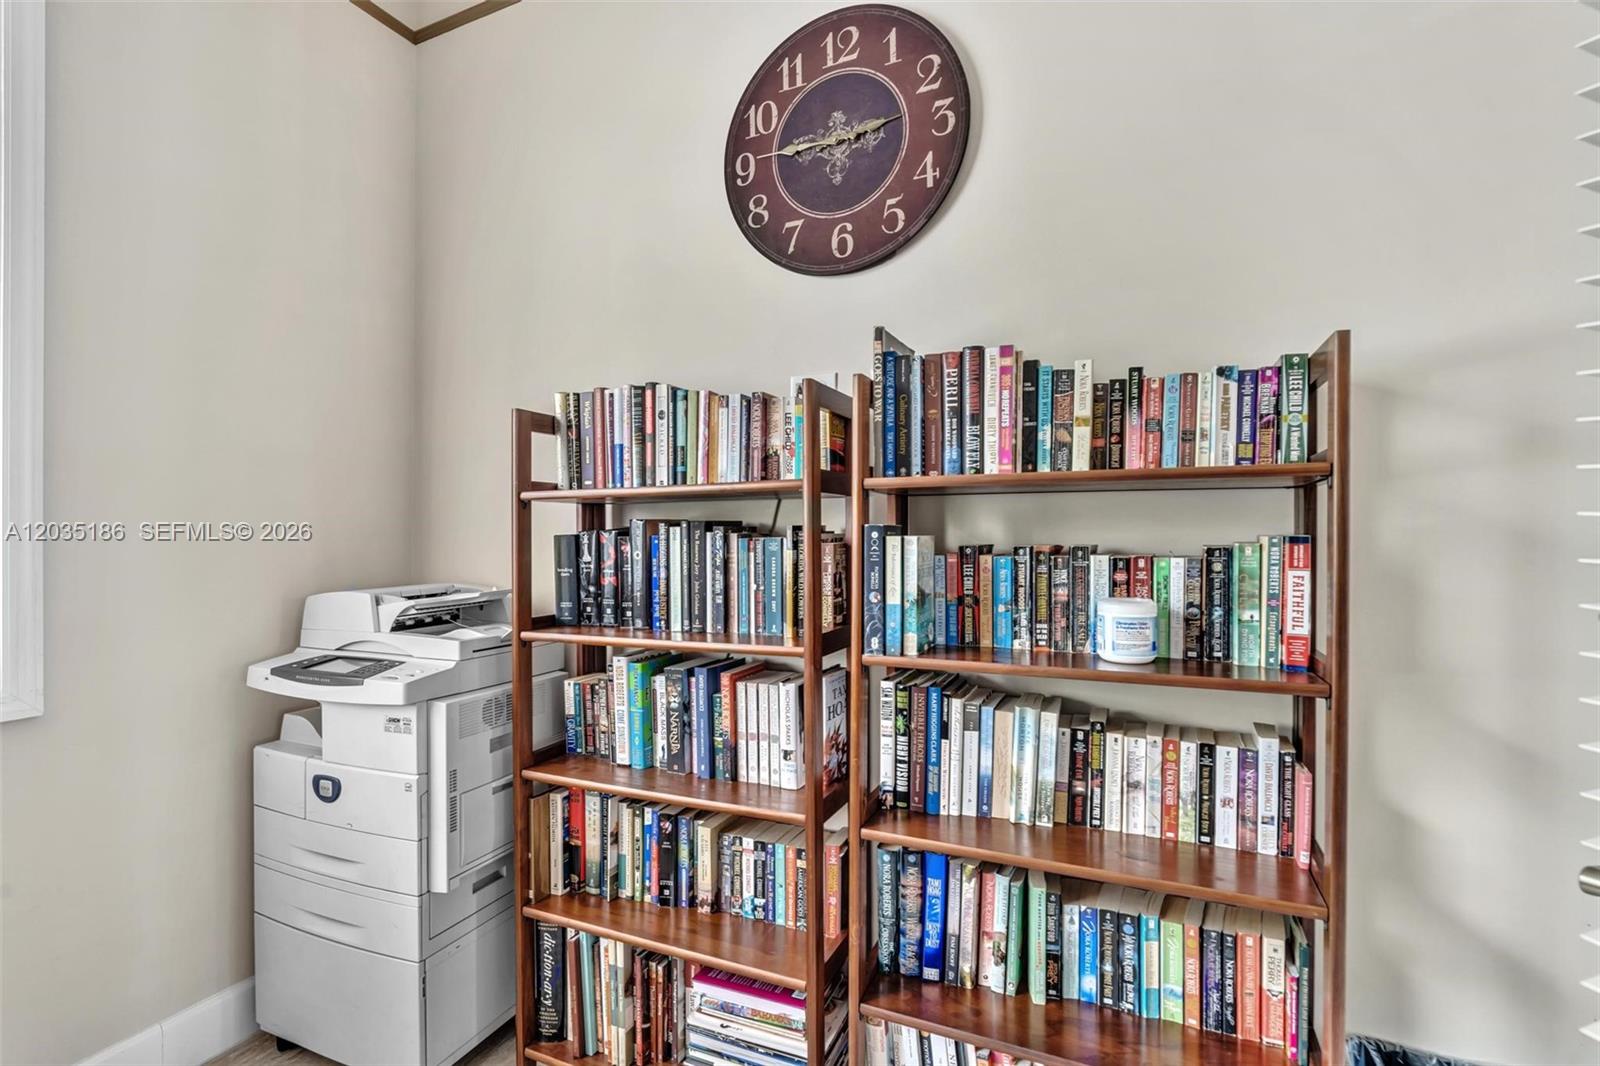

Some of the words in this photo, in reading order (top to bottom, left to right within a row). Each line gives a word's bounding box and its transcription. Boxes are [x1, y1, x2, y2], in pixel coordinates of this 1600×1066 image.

[820, 26, 860, 69] 12
[882, 27, 902, 65] 1
[777, 53, 807, 94] 11
[915, 54, 942, 94] 2
[744, 100, 778, 140] 10
[931, 97, 956, 136] 3
[735, 152, 756, 187] 9
[913, 151, 940, 188] 4
[747, 194, 769, 228] 8
[881, 194, 906, 234] 5
[782, 218, 805, 255] 7
[831, 222, 854, 258] 6
[874, 355, 883, 383] GOES
[873, 385, 882, 399] TO
[946, 368, 958, 411] PERIL
[1041, 378, 1049, 399] STARTS
[1290, 376, 1303, 389] LEE
[873, 400, 882, 422] WAR
[898, 394, 908, 425] Culinary
[1041, 401, 1049, 419] WITH
[1242, 396, 1250, 416] MICHAEL
[1260, 384, 1271, 414] BRENNAN
[1290, 390, 1303, 412] CHILD
[583, 401, 591, 429] Whiplash
[752, 403, 760, 420] NORA
[784, 412, 792, 427] LEE
[886, 404, 894, 426] SPATULA
[752, 422, 760, 448] ROBERTS
[966, 425, 980, 451] BLOW
[988, 417, 996, 437] DIRTY
[1242, 418, 1250, 442] CONNELLY
[784, 428, 792, 451] CHILD
[898, 427, 908, 455] Artistry
[1290, 430, 1300, 450] Wanted
[966, 453, 980, 469] FLY
[1270, 547, 1280, 564] NORA
[964, 564, 974, 576] LEE
[1270, 566, 1280, 594] ROBERTS
[964, 577, 974, 594] CHILD
[1292, 575, 1304, 630] FAITHFUL
[1268, 612, 1278, 652] Entanglements
[616, 682, 625, 706] ROBERTS
[722, 687, 730, 708] NORA
[882, 687, 892, 698] SAM
[882, 700, 892, 720] WALTON
[568, 720, 576, 748] GRAVITY
[670, 712, 680, 754] NARNIA
[722, 710, 730, 739] ROBERTS
[897, 736, 908, 760] NIGHT
[897, 763, 908, 792] VISION
[1167, 770, 1176, 783] NORA
[1244, 768, 1255, 790] NORA
[1264, 762, 1274, 782] DAVID
[1164, 784, 1176, 805] ROBERTS
[1244, 790, 1255, 816] ROBERTS
[1264, 782, 1274, 812] BALDACCI
[1092, 806, 1101, 818] PREY
[882, 864, 892, 884] NORA
[906, 866, 918, 885] NORA
[927, 878, 941, 886] TAMI
[882, 885, 892, 916] ROBERTS
[906, 886, 918, 912] ROBERTS
[927, 887, 941, 896] HOAG
[985, 880, 993, 902] NORA
[1124, 944, 1134, 960] NORA
[1122, 961, 1134, 982] ROBERTS
[1268, 956, 1276, 985] PERRY
